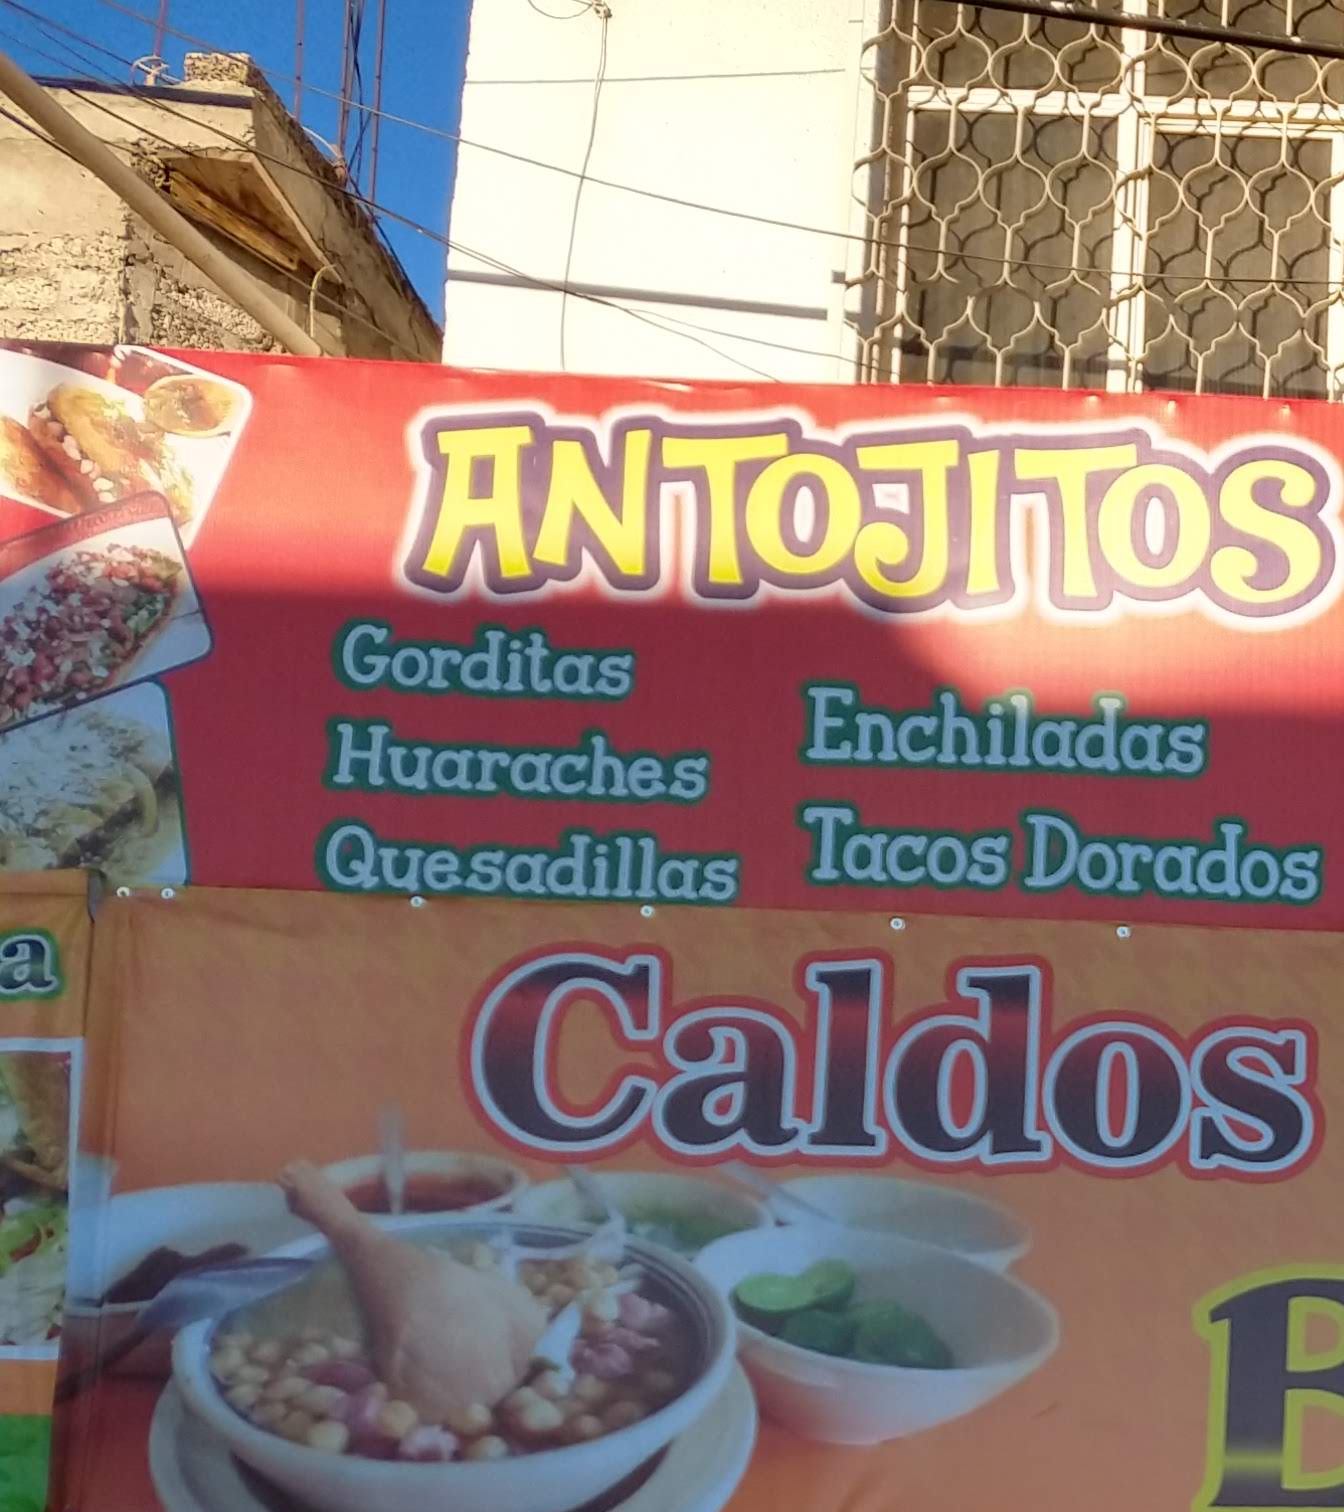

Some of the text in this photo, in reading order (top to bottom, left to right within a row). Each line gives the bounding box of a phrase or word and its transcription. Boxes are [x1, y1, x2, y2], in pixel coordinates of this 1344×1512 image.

[412, 416, 1332, 614] ANTOJITOS
[341, 622, 636, 696] Gorditas
[331, 722, 709, 800] Huaraches
[804, 685, 1206, 774] Enchiladas
[324, 822, 739, 901] Quesadillas
[802, 805, 1322, 900] Tacos Dorados
[472, 947, 1312, 1173] Caldos
